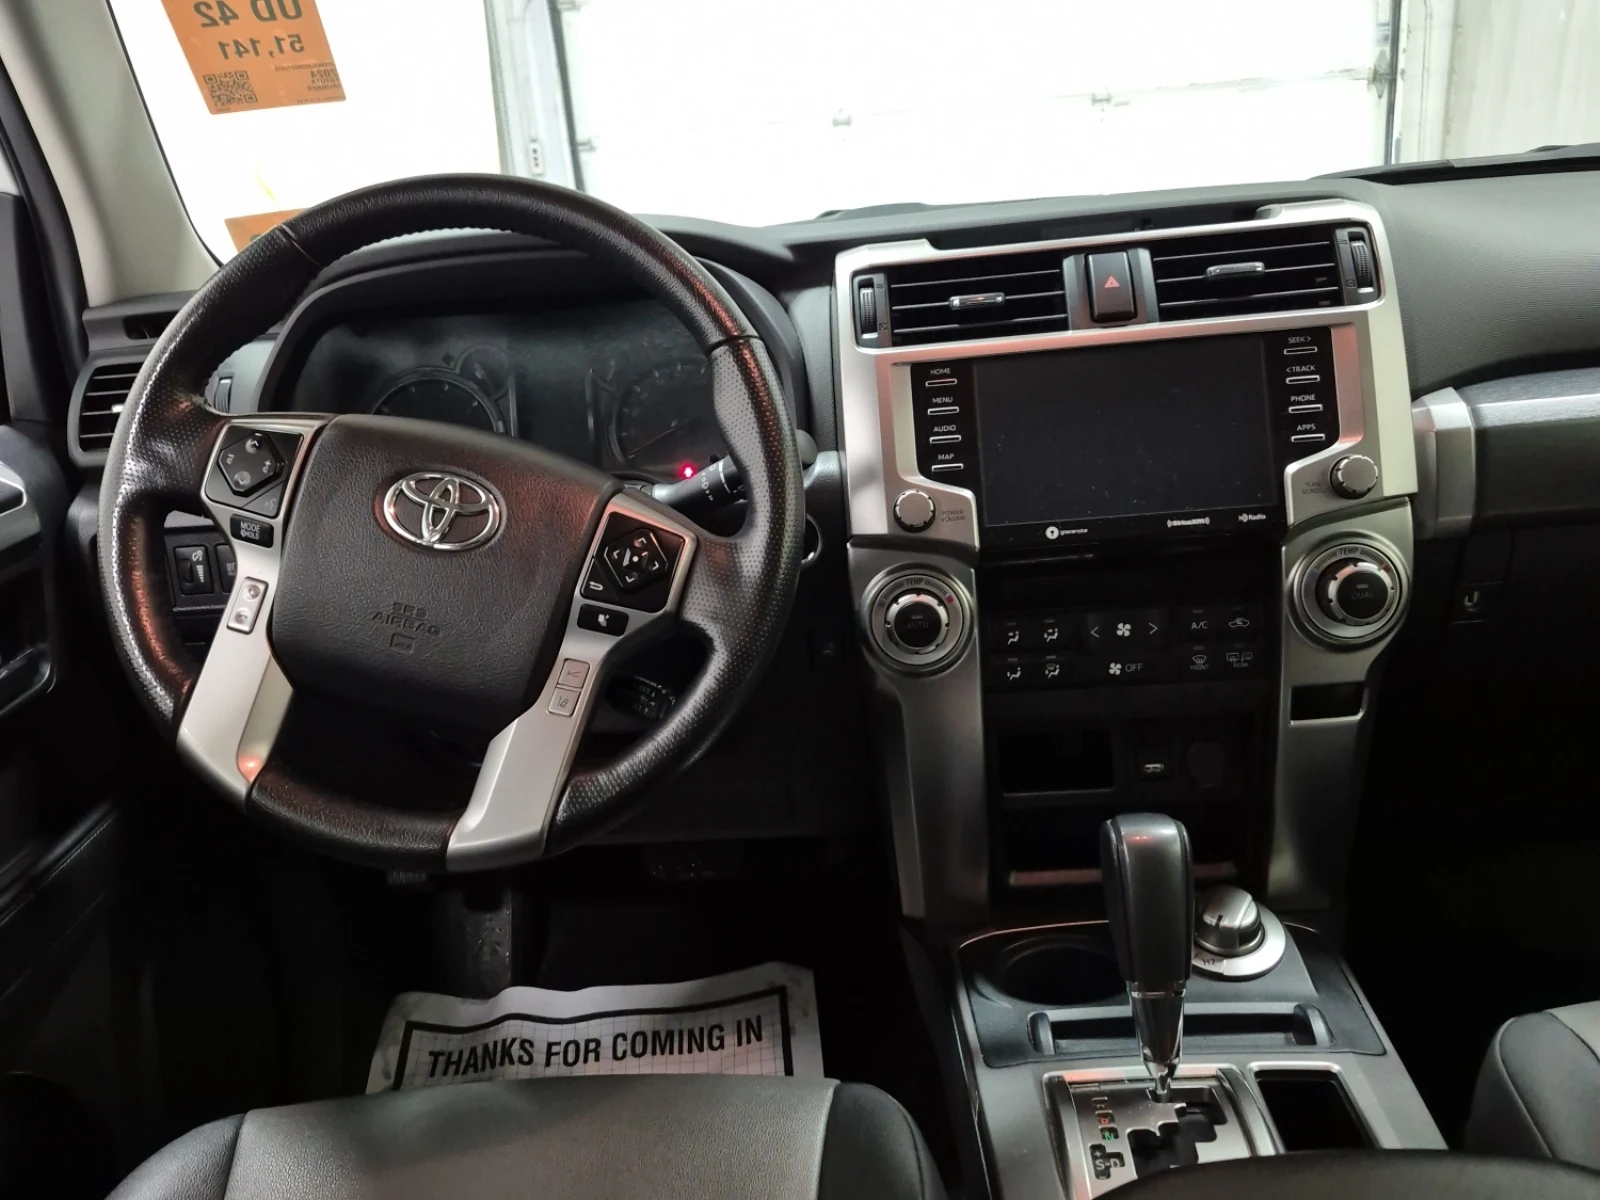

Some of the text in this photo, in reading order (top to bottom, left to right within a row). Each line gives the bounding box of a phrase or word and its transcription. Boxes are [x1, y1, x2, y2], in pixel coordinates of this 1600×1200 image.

[930, 367, 952, 375] HOME
[932, 396, 953, 404] MENU
[1290, 394, 1316, 402] PHONE
[933, 424, 957, 433] AUDIO
[1296, 423, 1316, 432] APPS
[937, 453, 955, 461] MAP
[240, 521, 261, 533] MODE
[1339, 547, 1360, 556] TEMP
[371, 611, 441, 637] AIRBAG
[1191, 621, 1209, 630] A/C
[1124, 662, 1143, 673] OFF
[427, 1015, 764, 1079] THANKS FOR COMING IN
